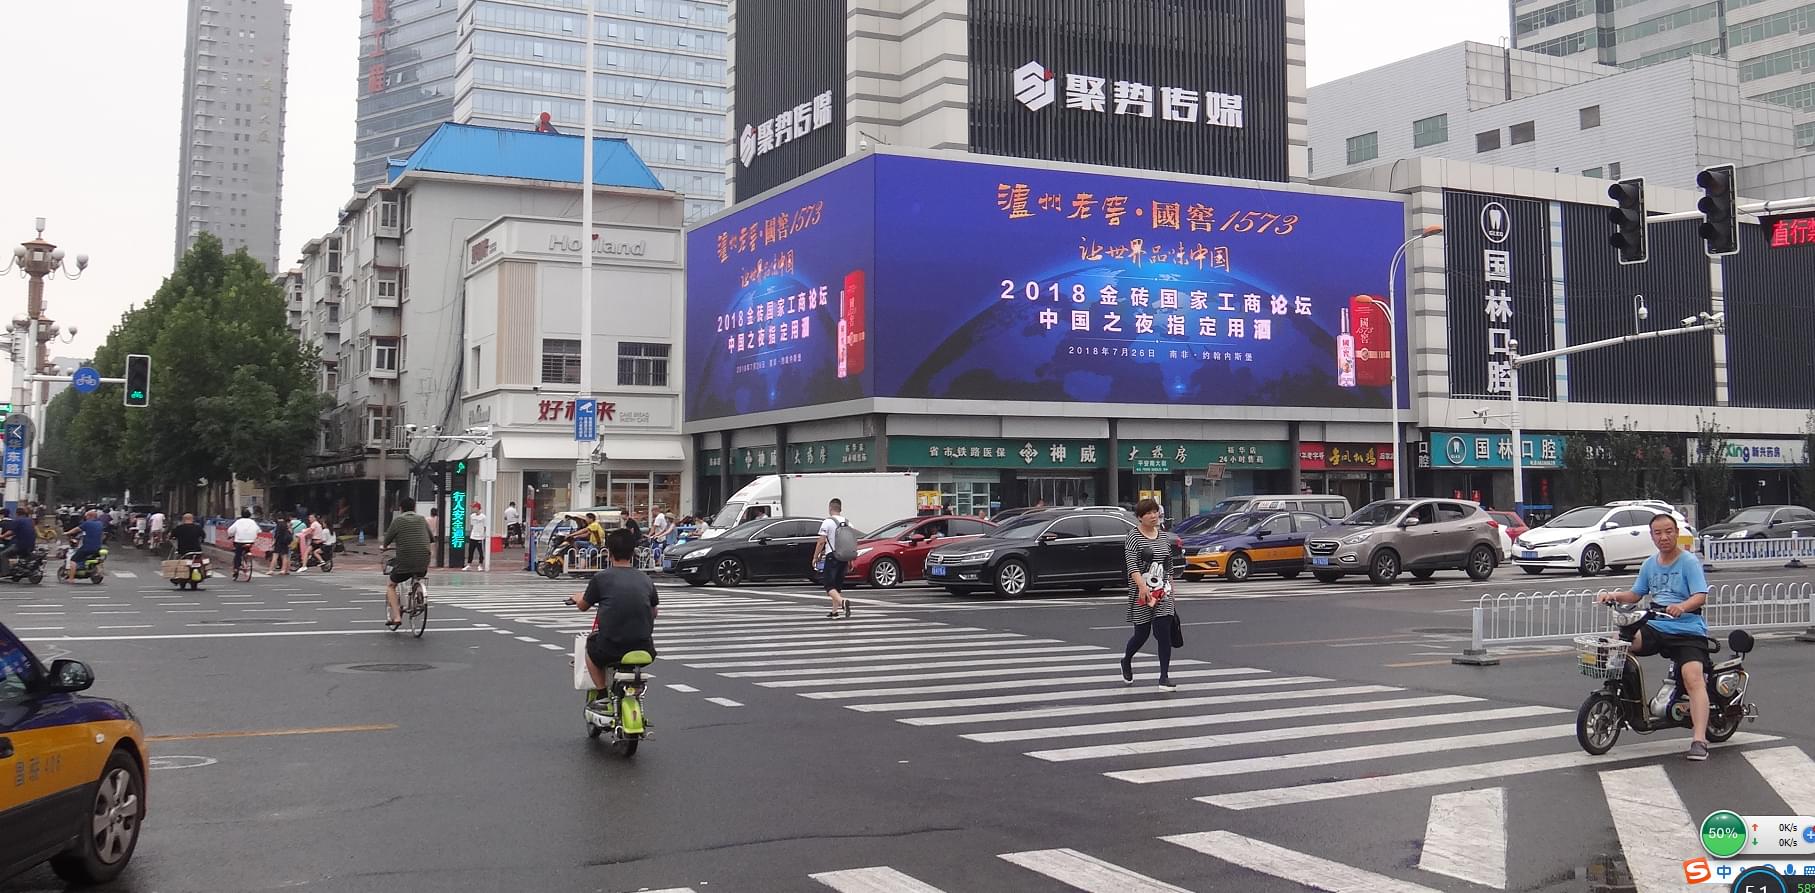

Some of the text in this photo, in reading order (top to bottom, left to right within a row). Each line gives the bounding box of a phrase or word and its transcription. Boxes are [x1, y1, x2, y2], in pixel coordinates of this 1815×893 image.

[1065, 73, 1244, 128] 聚势传媒
[756, 90, 833, 156] 聚势传媒
[1079, 236, 1231, 273] 让世界品味中国
[1039, 308, 1272, 341] 中国之夜指定用酒
[1483, 249, 1513, 394] 国林口腔
[1068, 345, 1156, 358] 2018年7月26日
[929, 446, 1006, 458] 省市铁路医保
[1049, 444, 1097, 463] 神威
[1475, 438, 1557, 460] 国林口腔
[1752, 446, 1780, 458] 新兴药房
[451, 491, 466, 548] 行人安全通行
